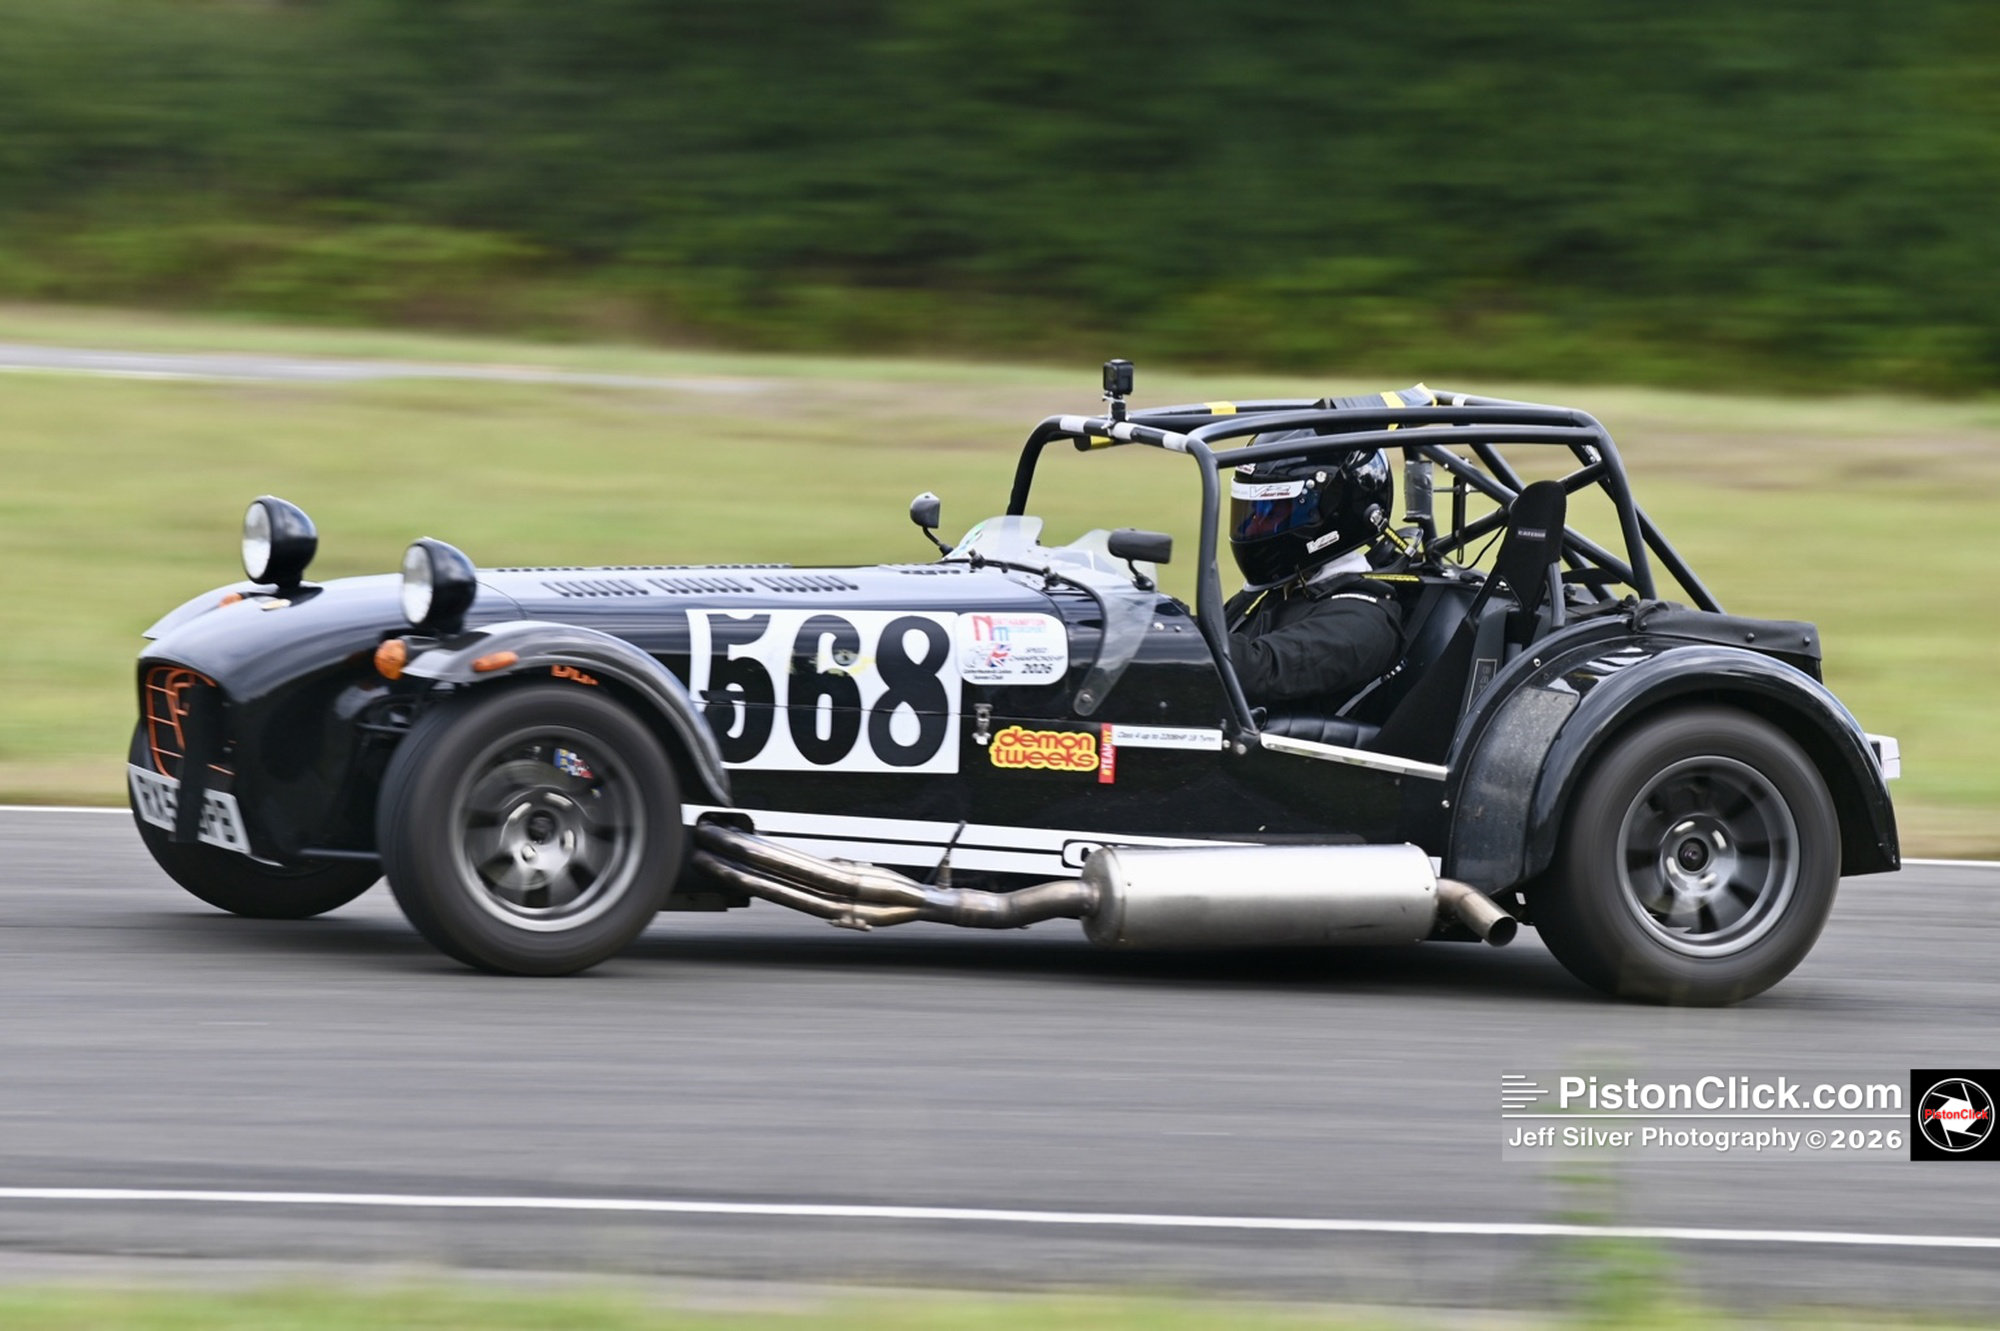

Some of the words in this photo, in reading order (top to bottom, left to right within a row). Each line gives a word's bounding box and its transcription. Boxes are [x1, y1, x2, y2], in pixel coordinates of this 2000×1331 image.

[1021, 663, 1053, 674] 2026
[704, 614, 950, 767] 568
[1000, 729, 1092, 750] demon
[994, 746, 1095, 767] tweeks
